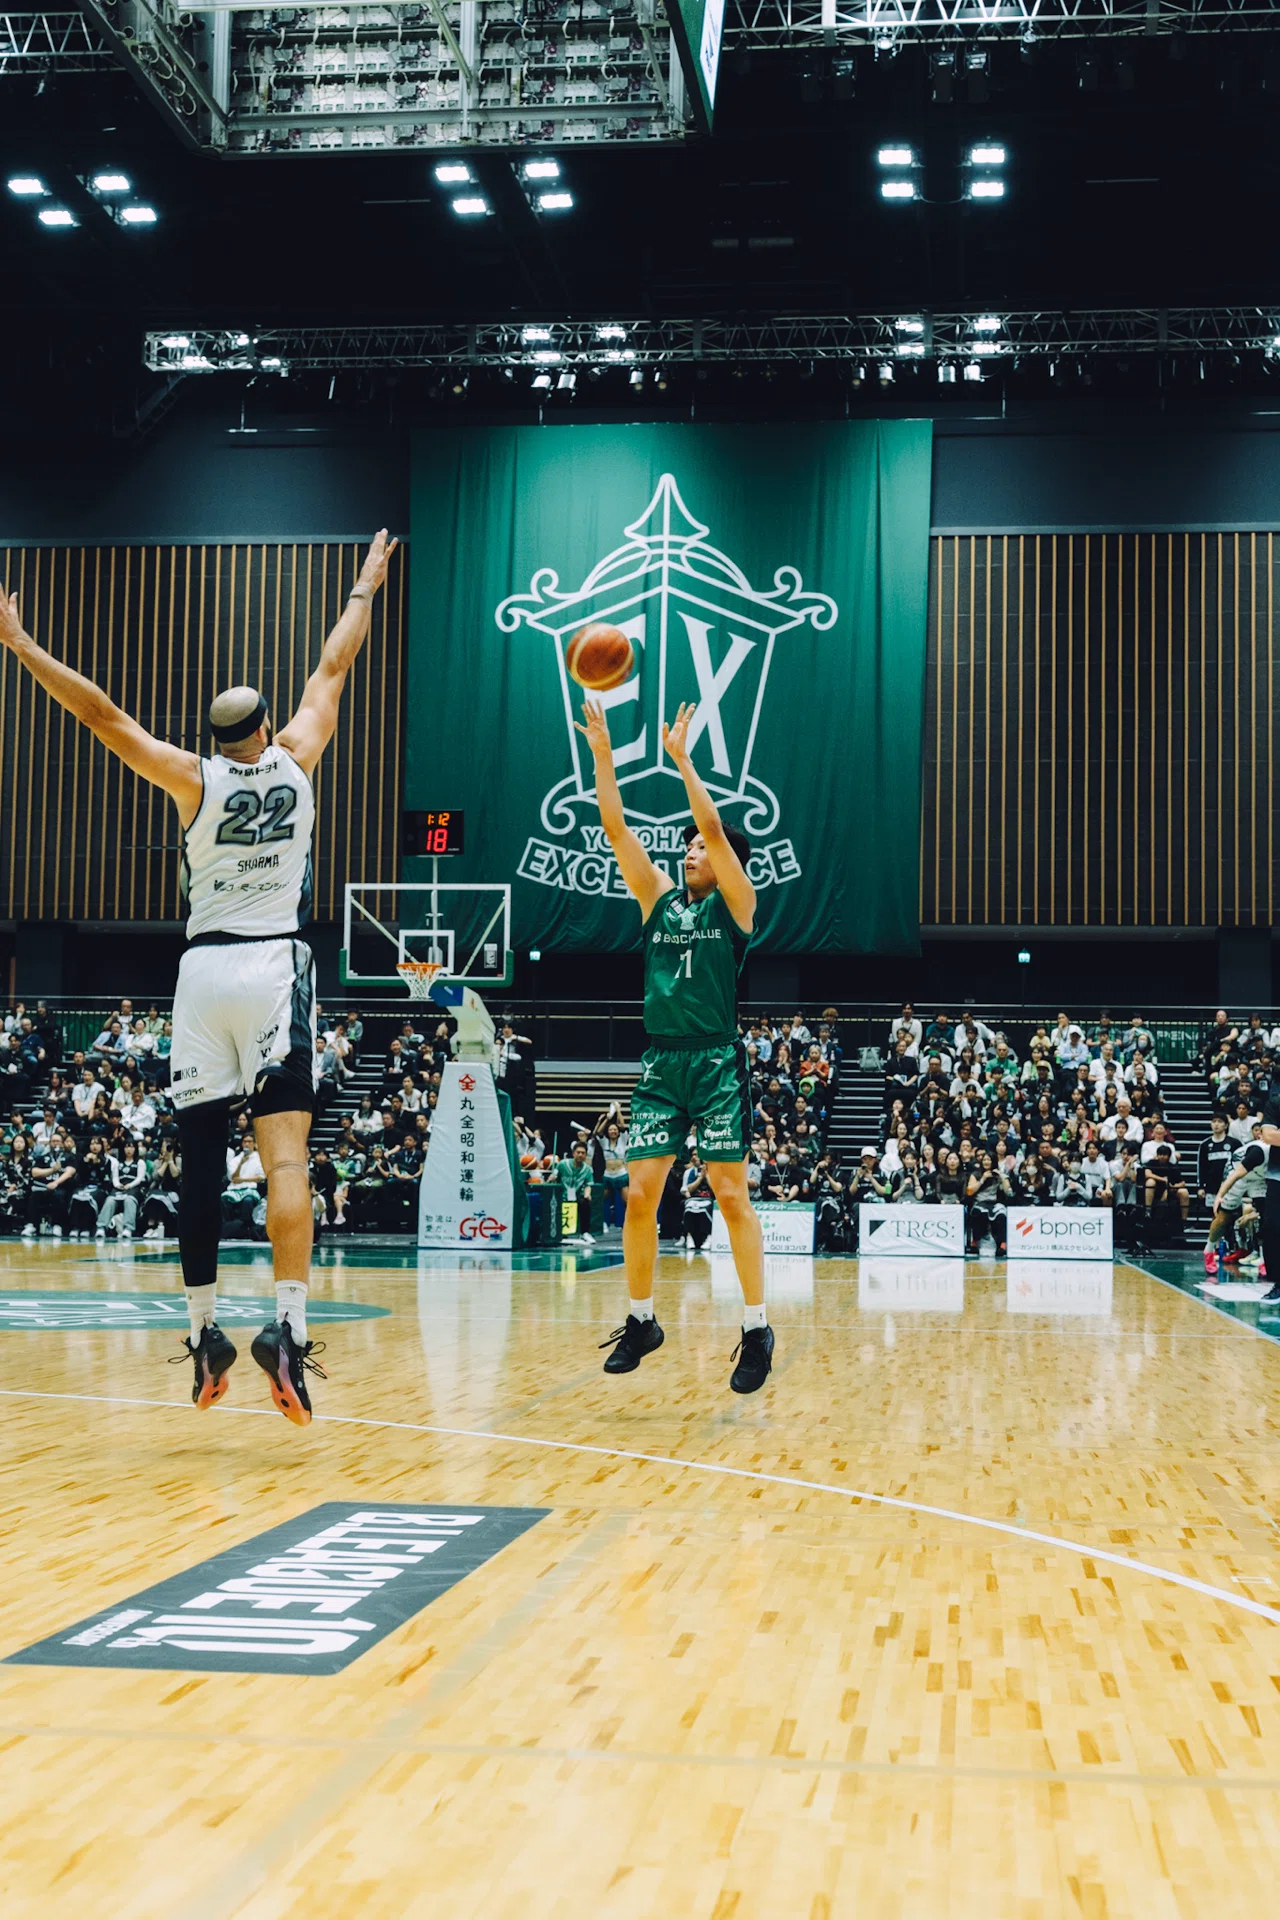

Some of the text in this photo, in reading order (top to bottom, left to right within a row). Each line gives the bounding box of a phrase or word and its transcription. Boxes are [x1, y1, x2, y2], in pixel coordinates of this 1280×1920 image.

[215, 784, 297, 846] 22
[427, 813, 451, 826] 1:12
[426, 828, 448, 853] 18
[237, 854, 280, 873] SHARMA
[181, 1066, 198, 1080] KKB
[459, 1096, 475, 1202] 丸全昭和運輸
[628, 1131, 669, 1148] KATO
[1040, 1218, 1104, 1238] bpnet
[179, 1512, 485, 1613] B.LEAGUE
